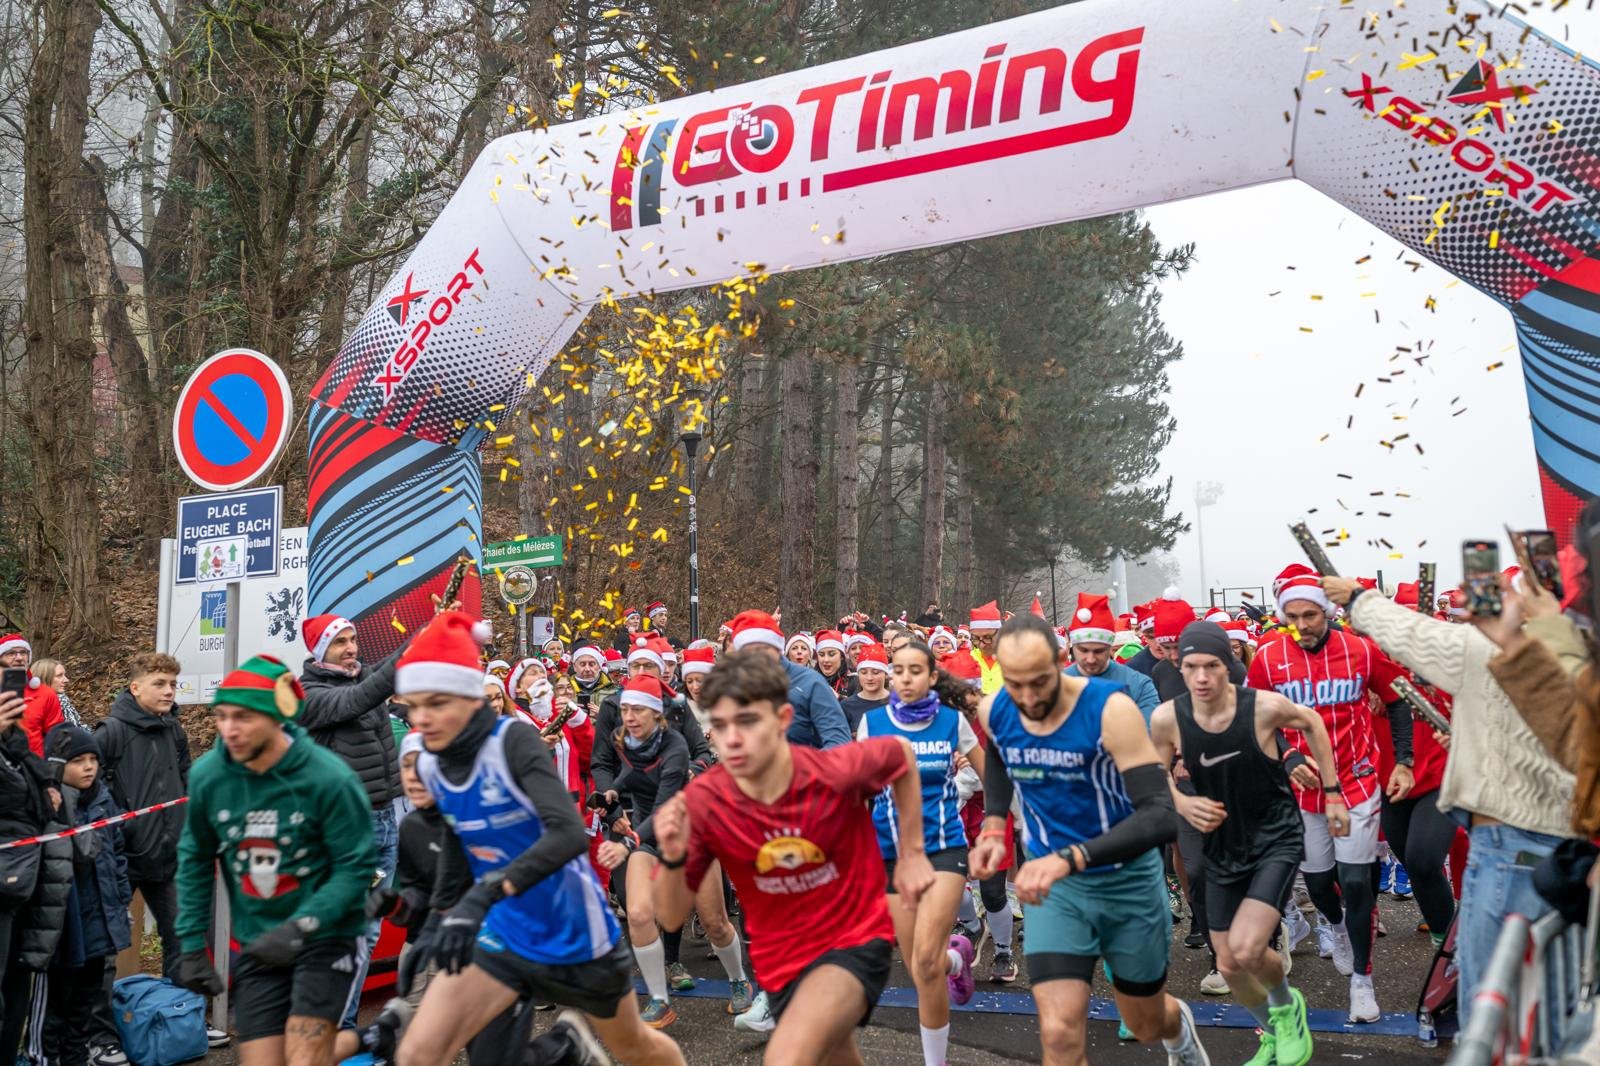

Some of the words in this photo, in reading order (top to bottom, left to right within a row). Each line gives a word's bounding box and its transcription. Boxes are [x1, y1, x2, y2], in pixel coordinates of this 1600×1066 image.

[374, 246, 485, 397] XSPORT
[207, 503, 248, 519] PLACE
[184, 522, 231, 540] EUGENE
[237, 518, 272, 534] BACH
[507, 544, 521, 555] des
[523, 540, 555, 553] Mélèzes
[1023, 747, 1085, 768] FORBACH
